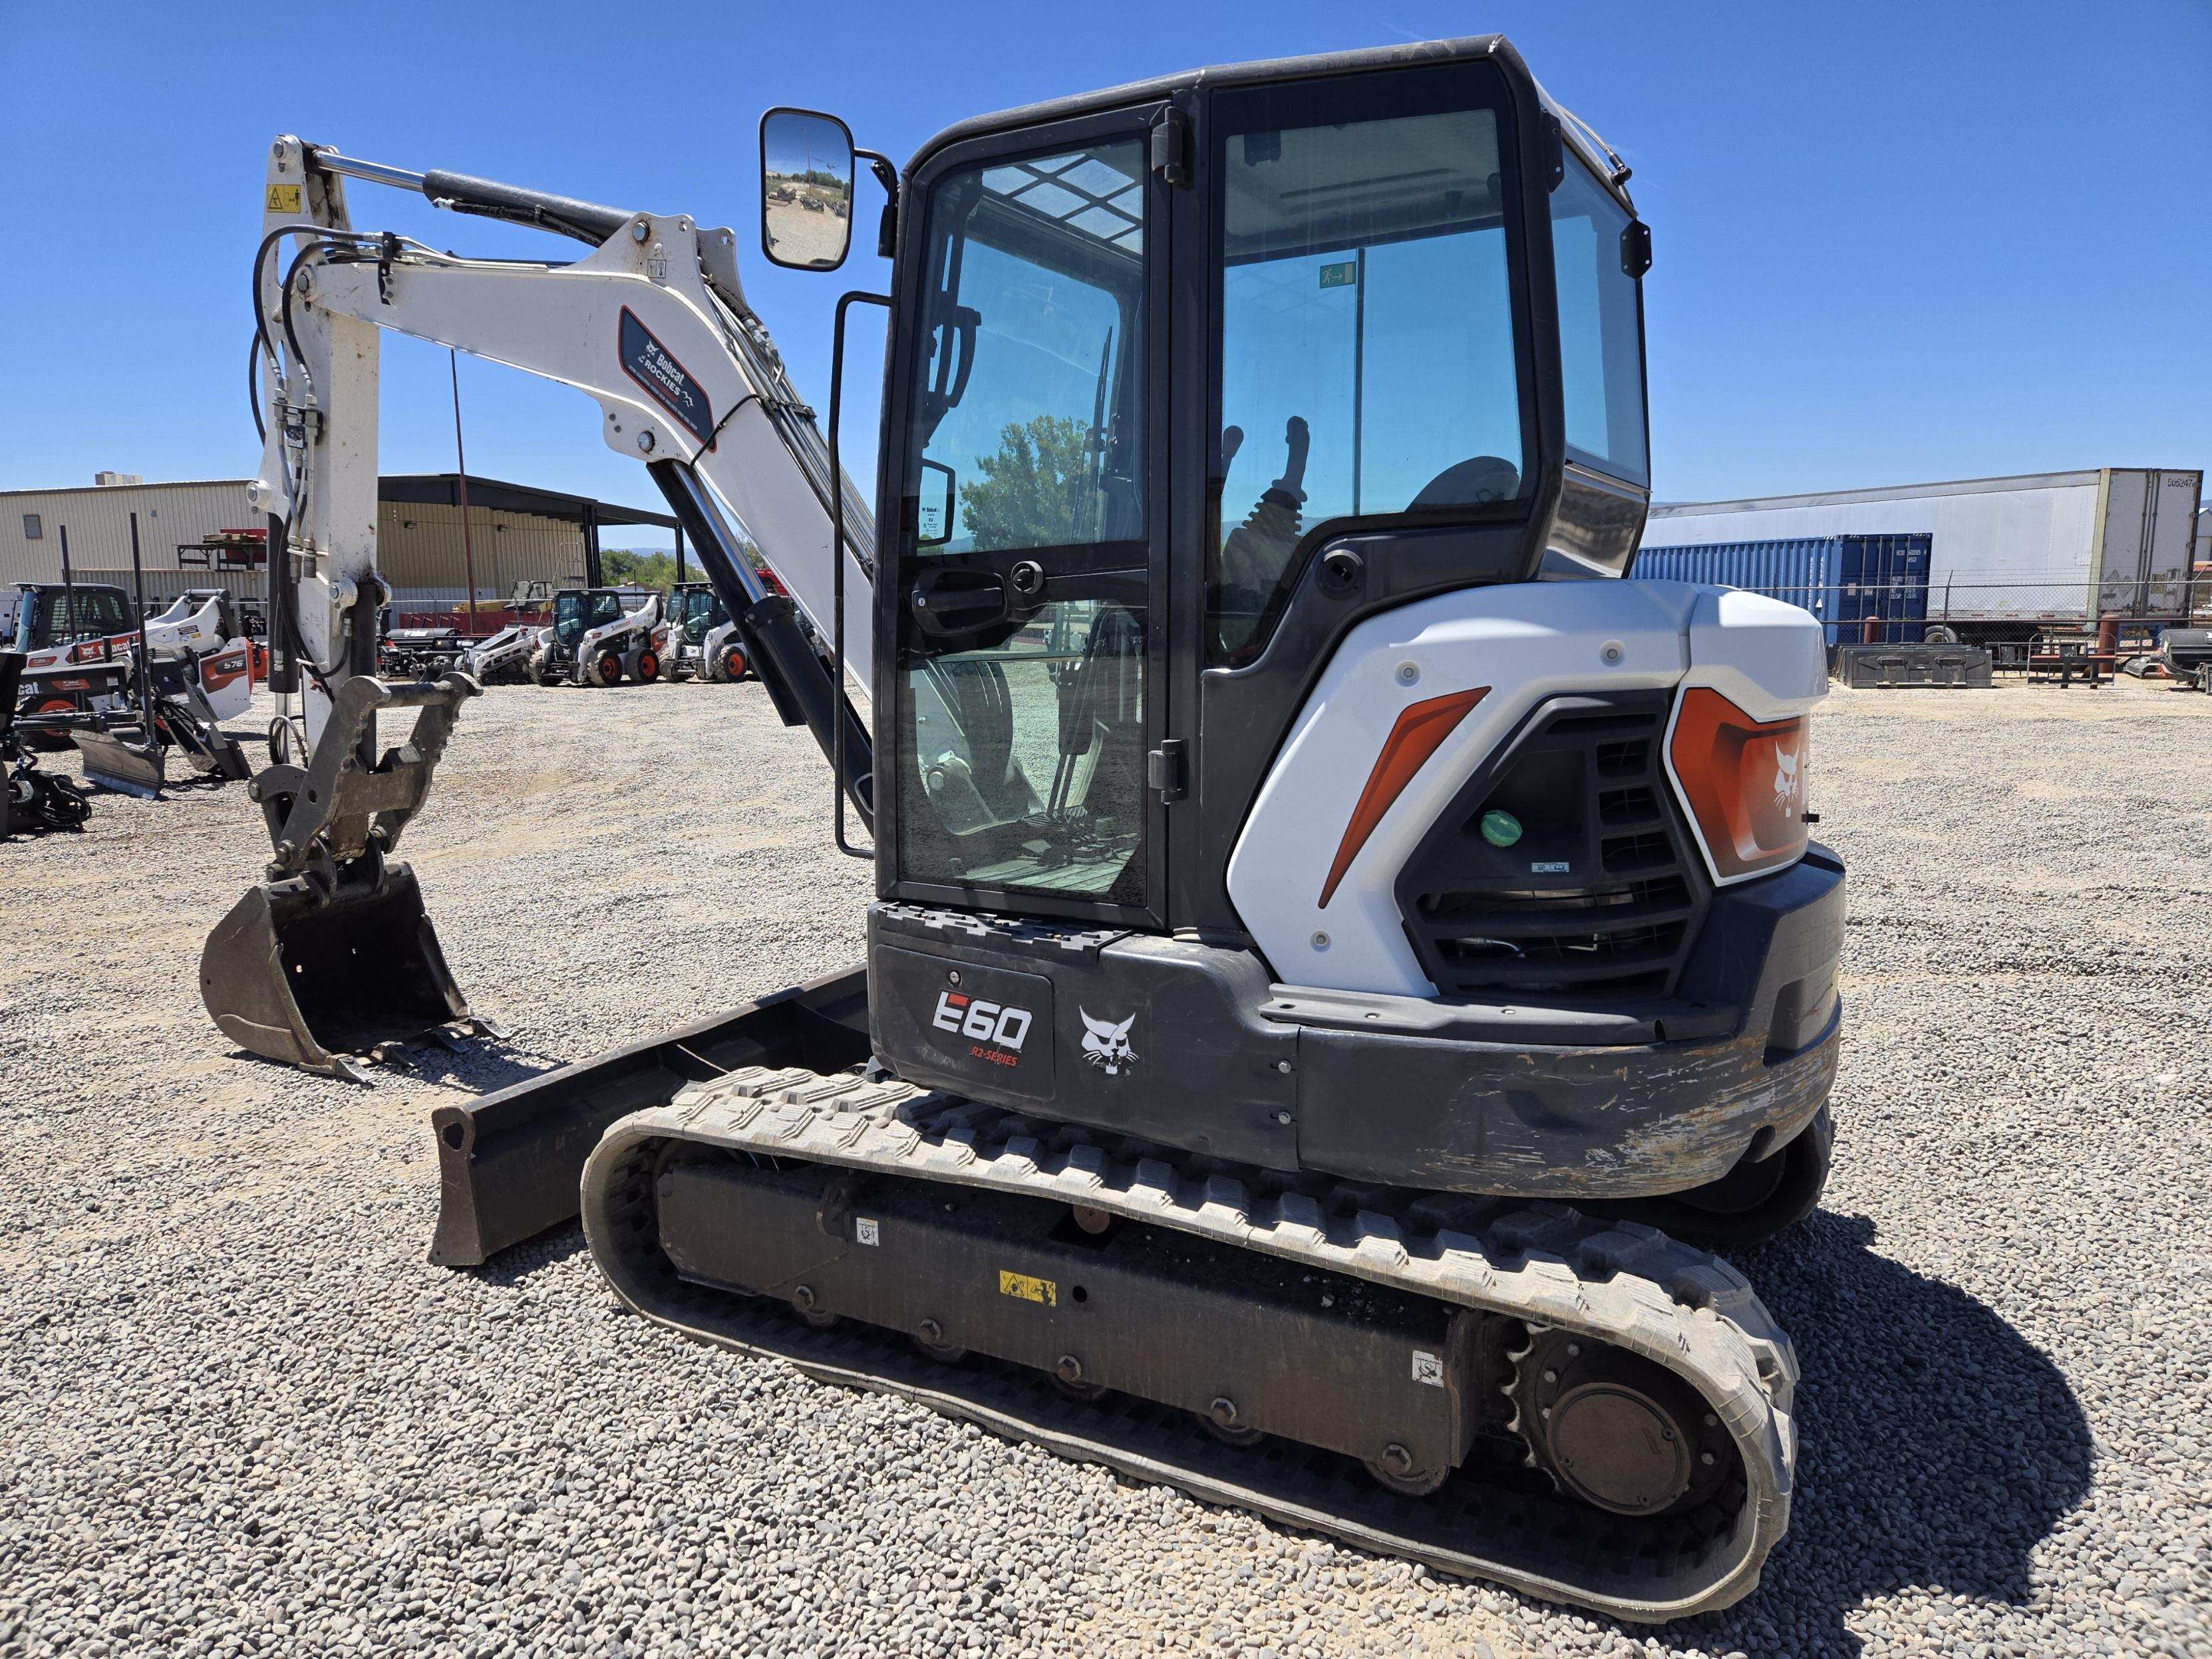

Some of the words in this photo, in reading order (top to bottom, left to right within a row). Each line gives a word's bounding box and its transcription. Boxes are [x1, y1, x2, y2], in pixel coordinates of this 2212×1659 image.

[644, 359, 681, 396] ROCKIES
[657, 353, 685, 386] Bobcat
[224, 659, 243, 669] S76
[932, 991, 1032, 1050] E60
[971, 1046, 1018, 1066] R2-SERIES
